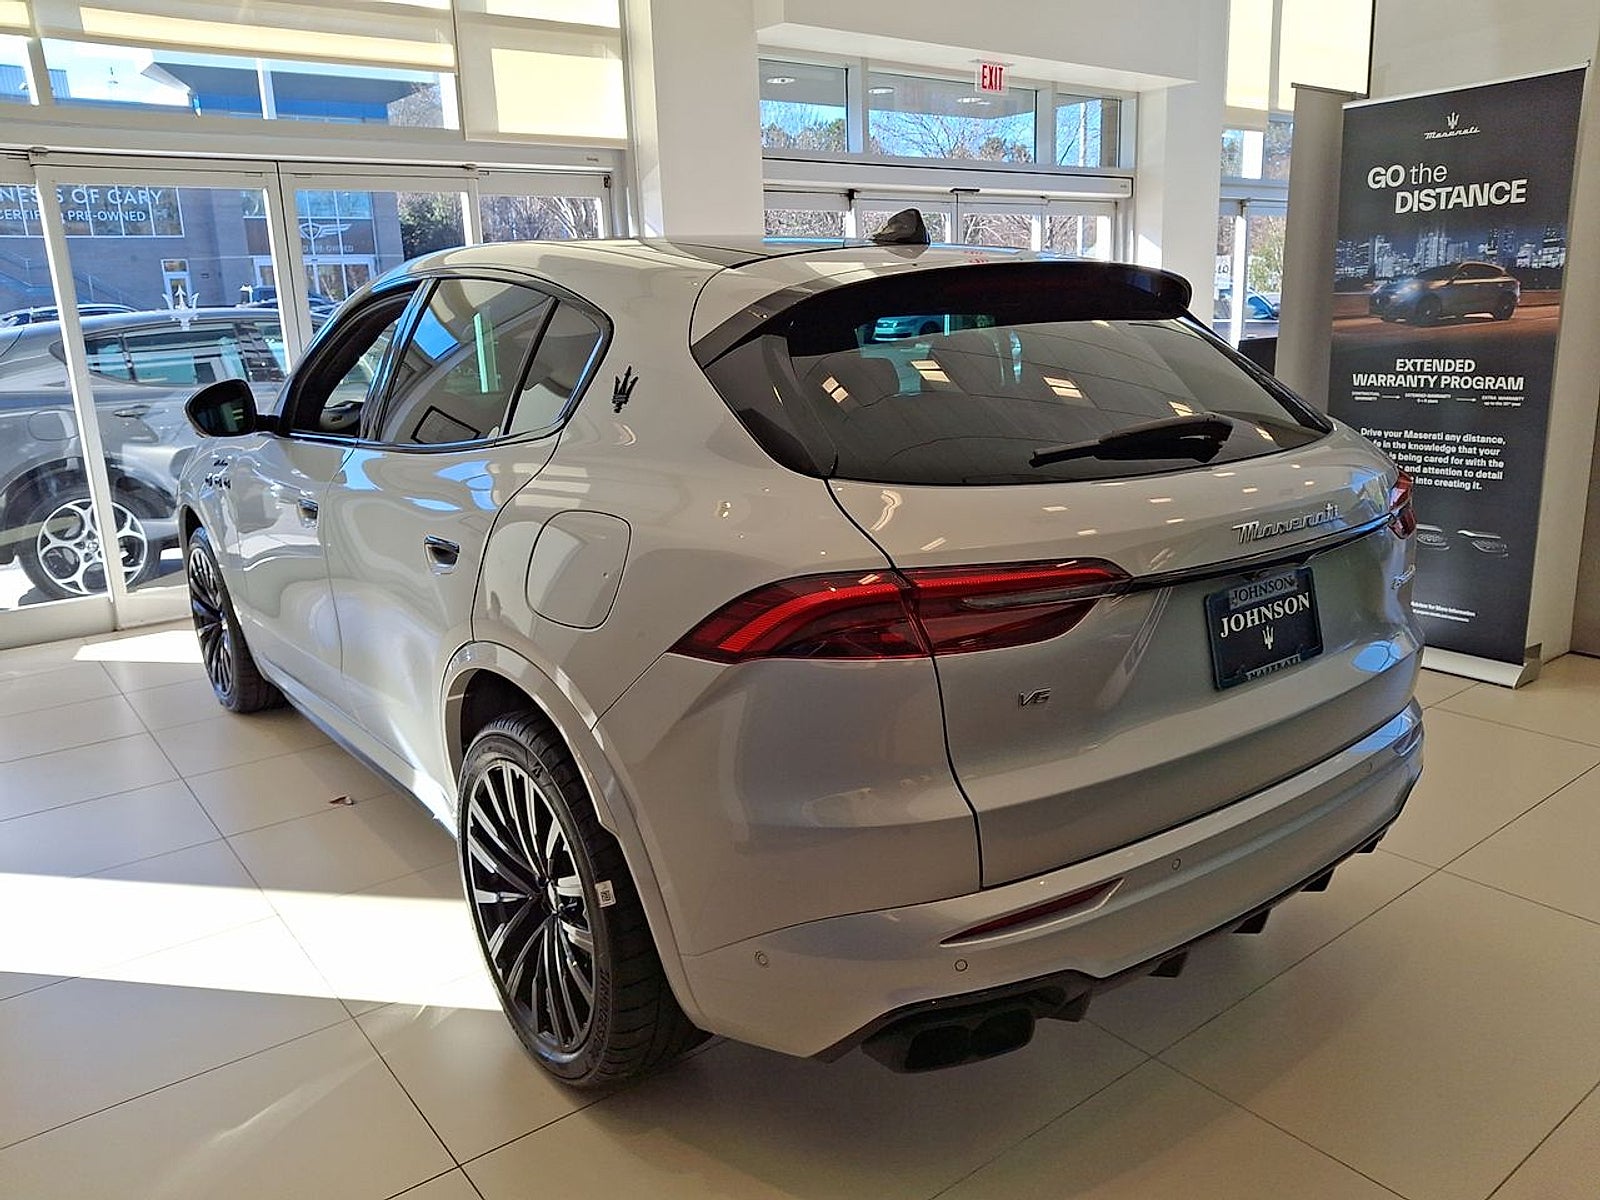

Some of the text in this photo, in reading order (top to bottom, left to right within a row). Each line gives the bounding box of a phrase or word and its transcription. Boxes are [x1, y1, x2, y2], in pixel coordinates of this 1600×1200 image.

[981, 64, 1004, 91] EXIT
[1424, 126, 1481, 140] Maserati
[1367, 163, 1448, 189] GO the
[72, 188, 100, 205] OF
[107, 189, 163, 206] CARY
[1394, 178, 1528, 214] DISTANCE
[67, 210, 146, 223] PRE-OWNED
[1395, 358, 1476, 373] EXTENDED
[1352, 373, 1524, 391] WARRANTY PROGRAM
[1360, 428, 1507, 445] Drive your Maserati any distance,
[1383, 440, 1391, 448] in
[1392, 440, 1407, 449] the
[1408, 441, 1457, 454] knowledge
[1458, 443, 1477, 455] that
[1479, 446, 1501, 457] your
[1398, 452, 1421, 463] being
[1424, 454, 1449, 464] cared
[1450, 455, 1464, 465] for
[1465, 457, 1487, 467] with
[1488, 458, 1504, 468] the
[1404, 464, 1421, 473] and
[1422, 465, 1462, 477] attention
[1464, 468, 1474, 477] to
[1475, 469, 1503, 480] detail
[1415, 477, 1433, 486] into
[1434, 478, 1471, 491] creating
[1472, 481, 1483, 490] it.
[1232, 503, 1342, 544] Maserati
[1231, 574, 1299, 606] JOHNSON
[1220, 592, 1310, 638] JOHNSON
[1018, 687, 1051, 706] V6
